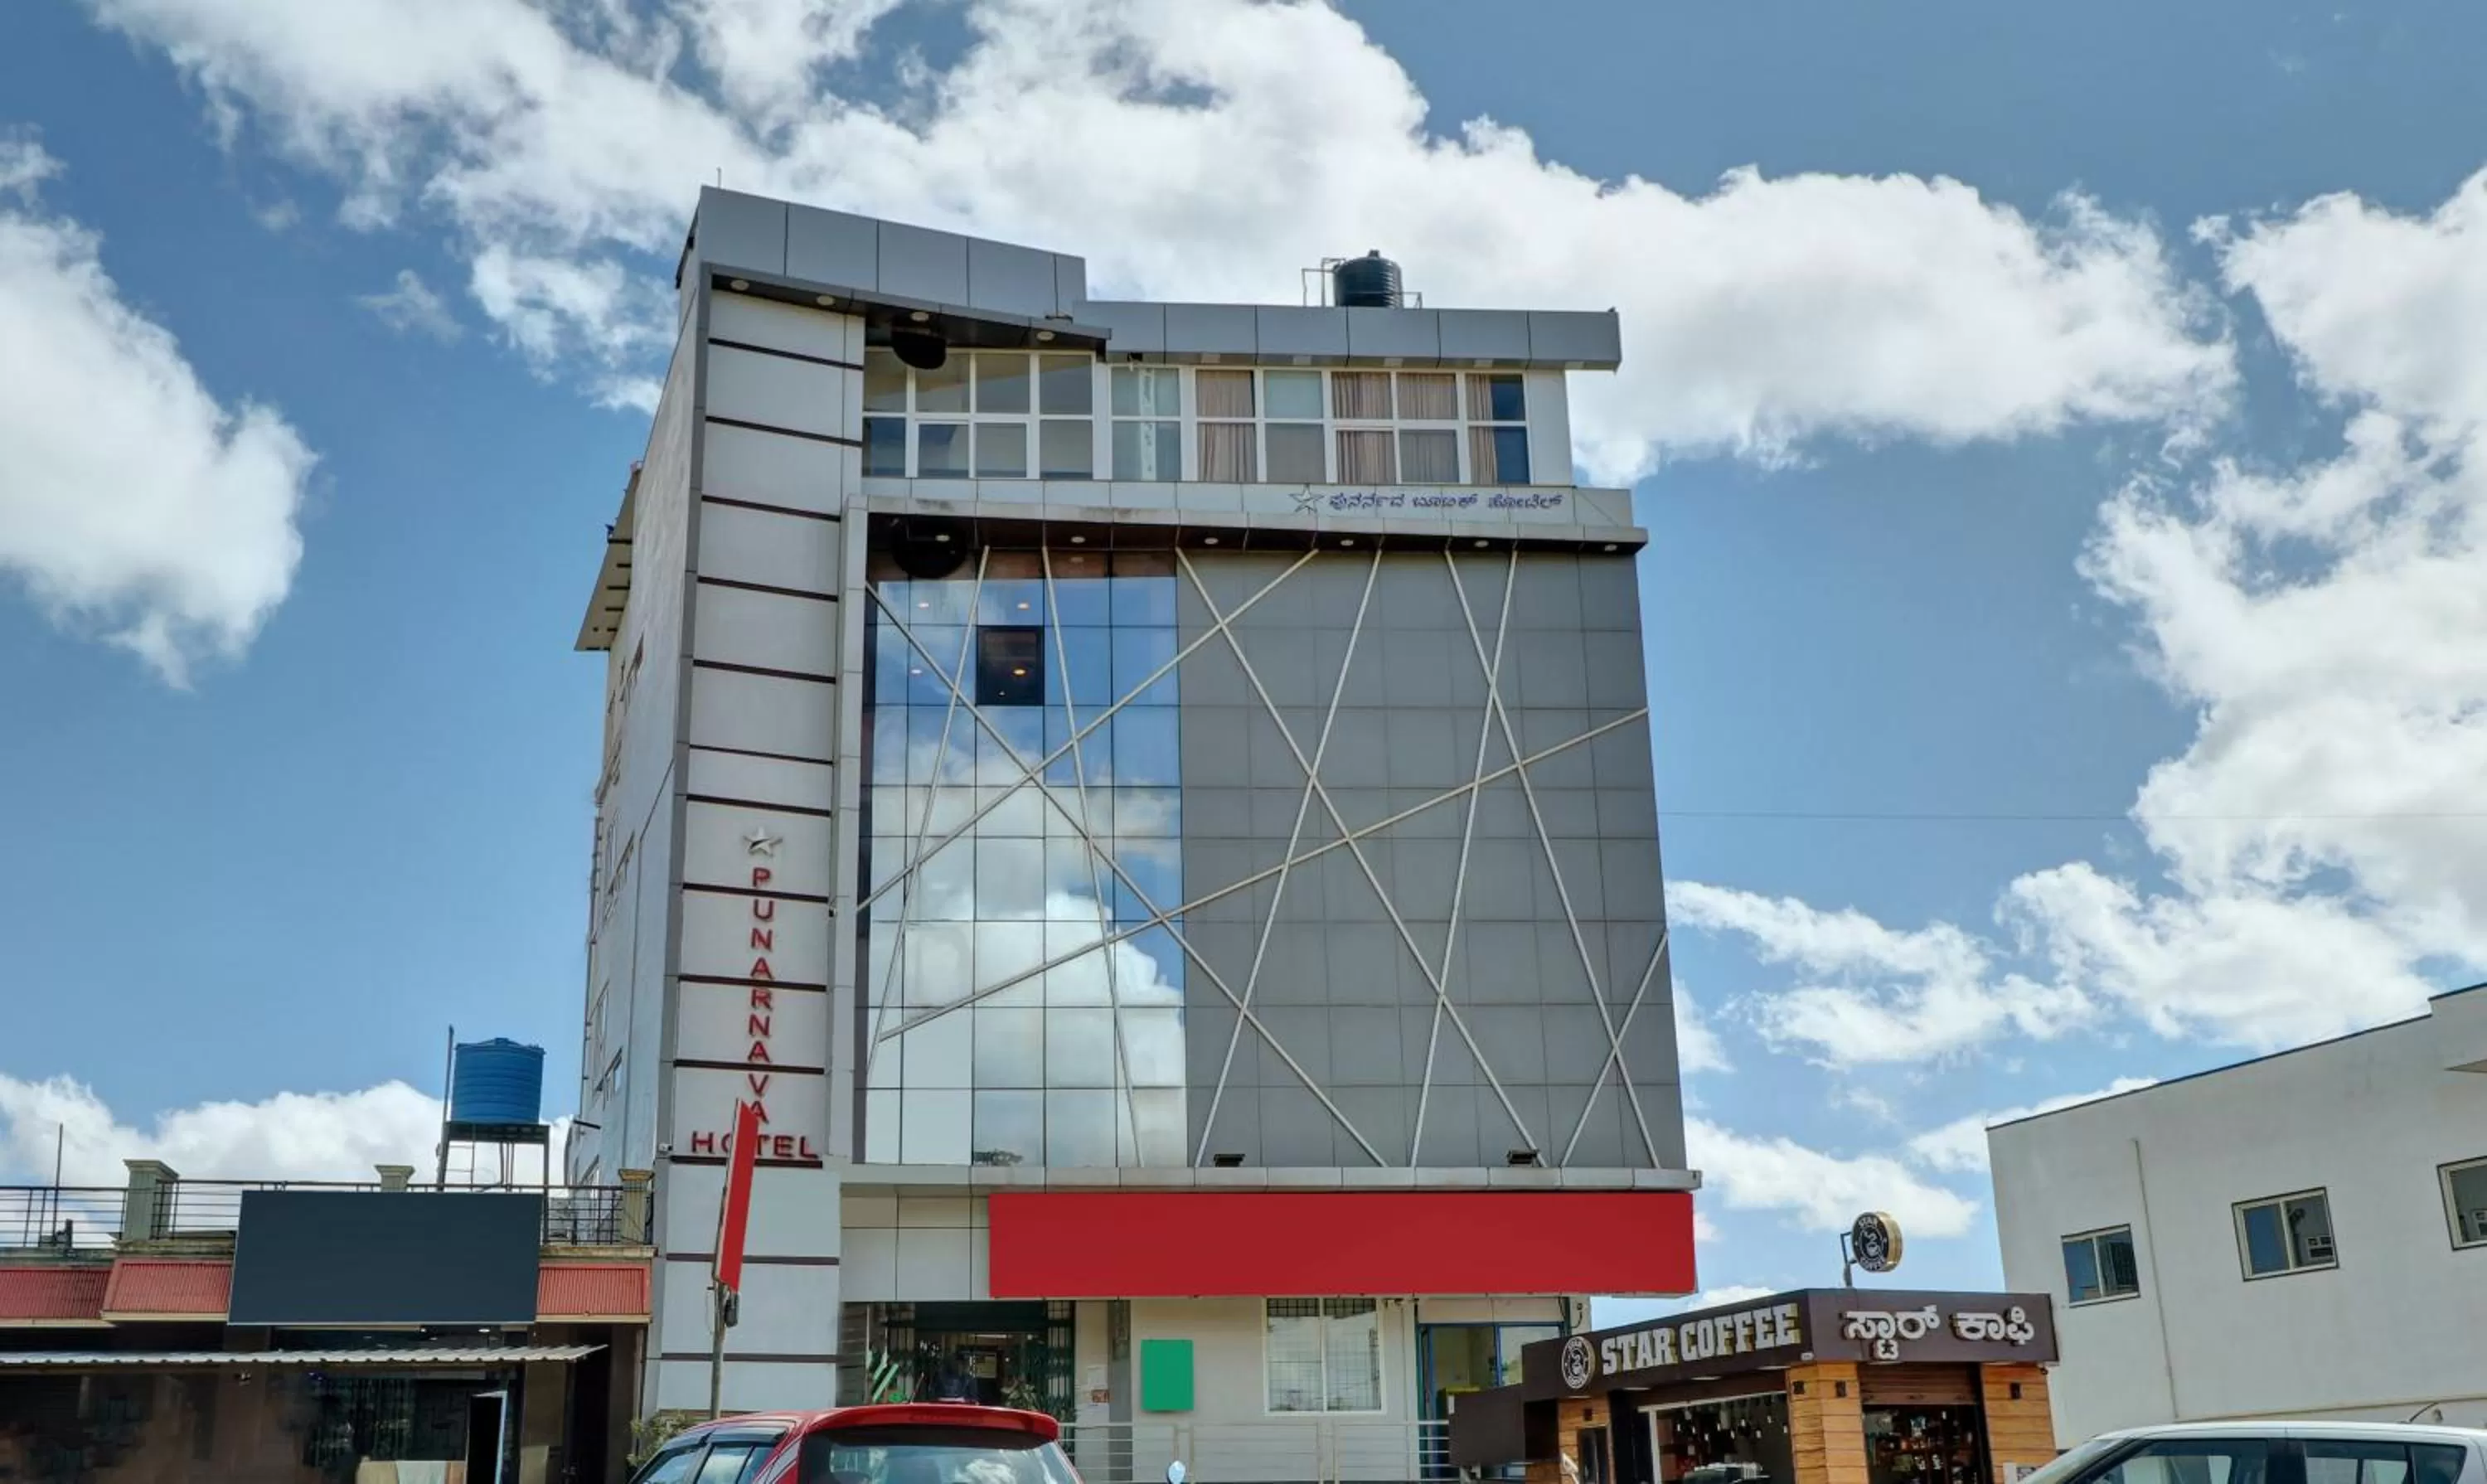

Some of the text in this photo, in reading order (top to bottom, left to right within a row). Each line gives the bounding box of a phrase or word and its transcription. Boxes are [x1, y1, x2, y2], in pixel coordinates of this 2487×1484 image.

[748, 866, 774, 1124] PUNARNAVA
[1601, 1302, 1799, 1375] STAR COFFEE
[1845, 1304, 2034, 1360] ಸ್ಟಾರ್ ಕಾಫಿ
